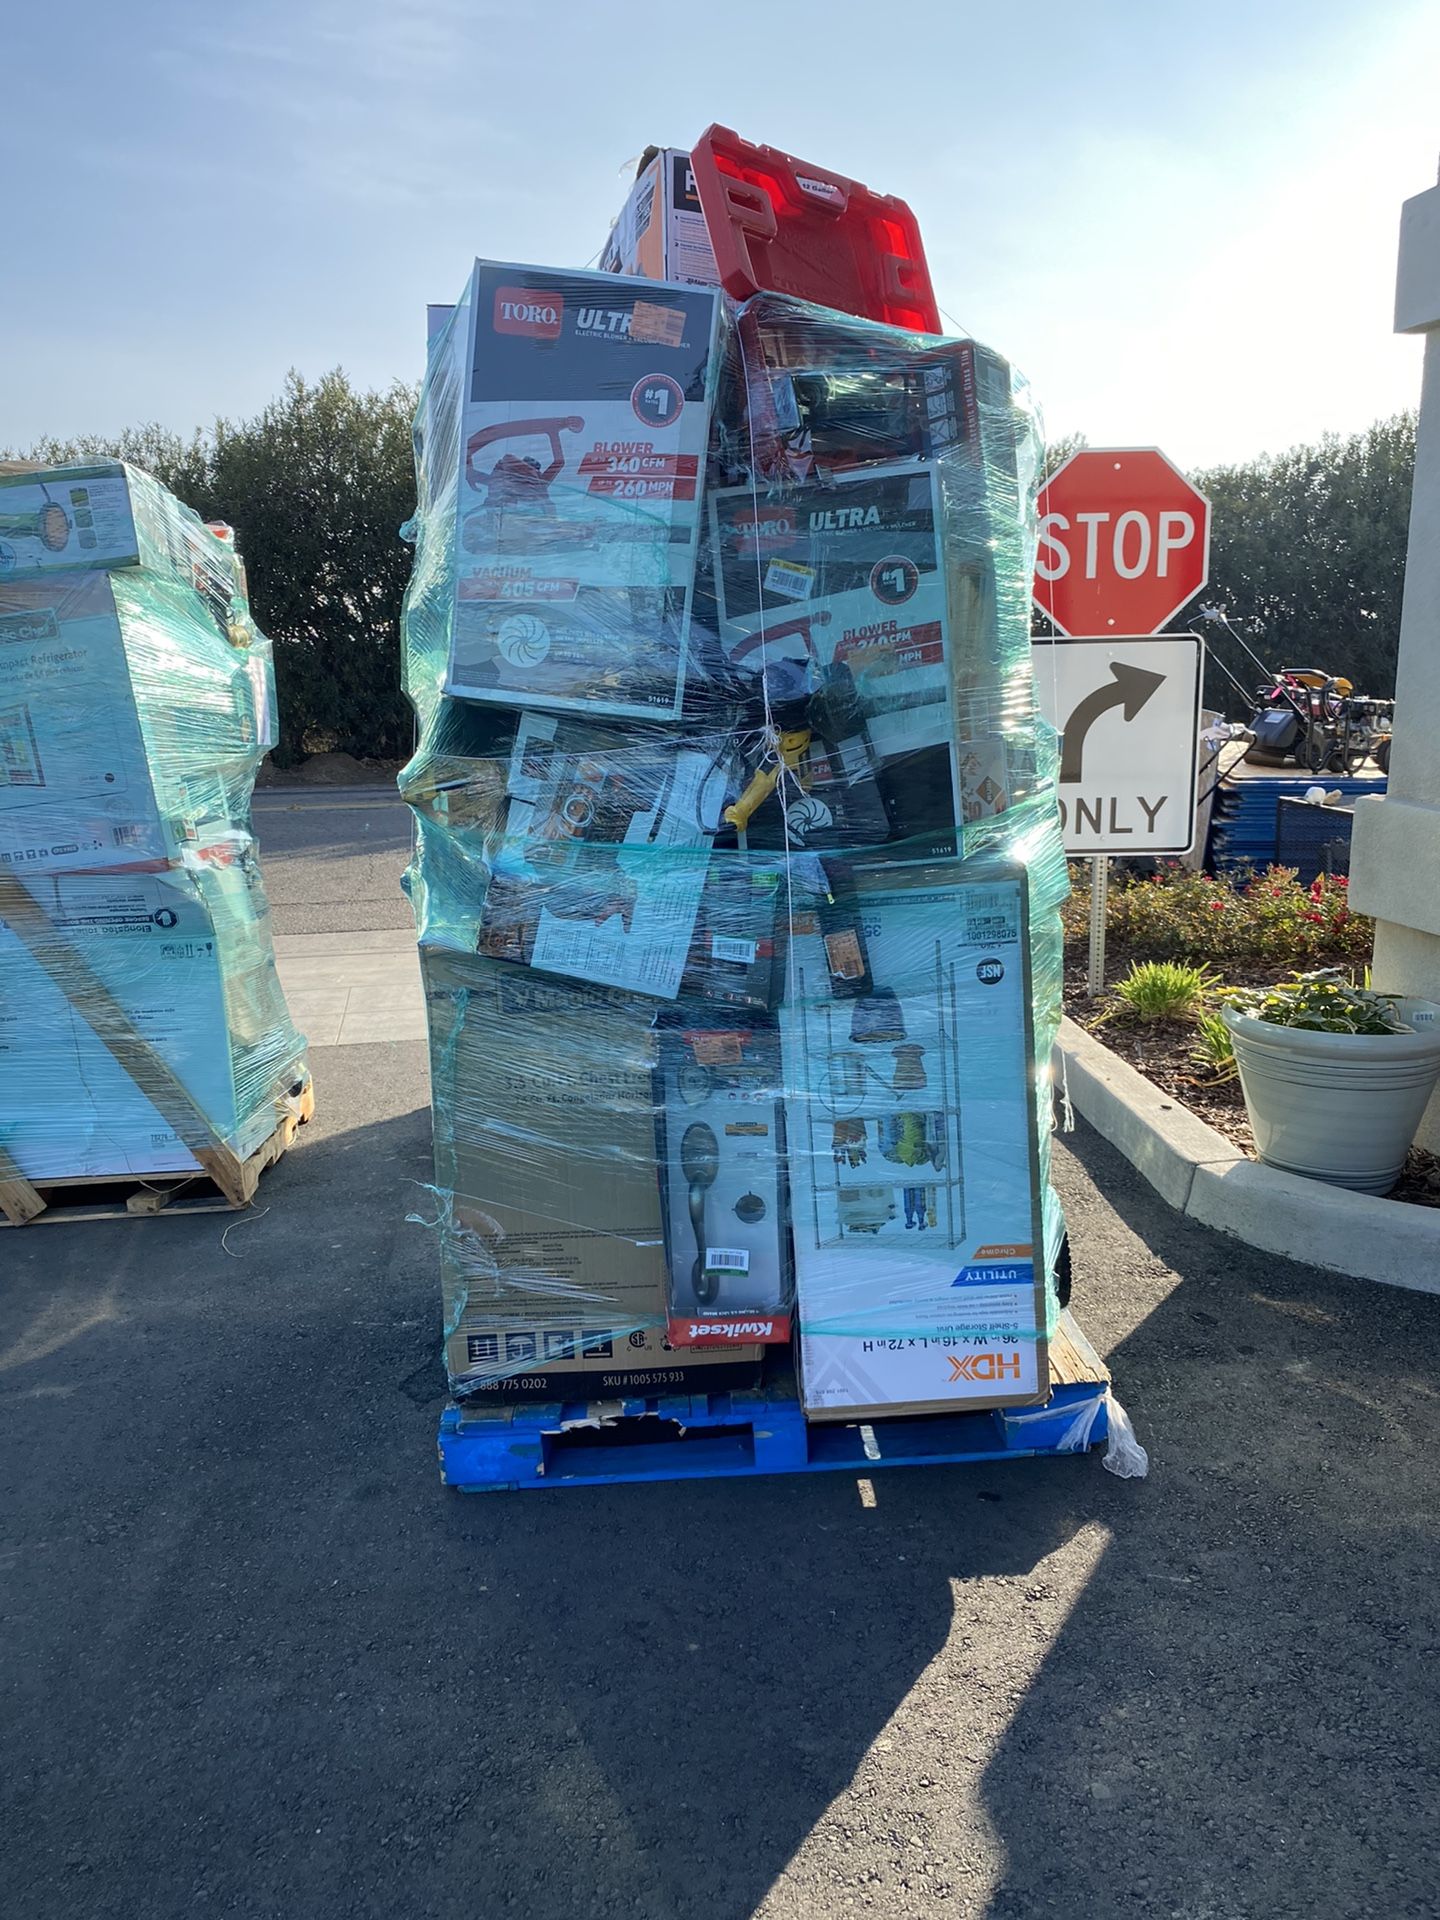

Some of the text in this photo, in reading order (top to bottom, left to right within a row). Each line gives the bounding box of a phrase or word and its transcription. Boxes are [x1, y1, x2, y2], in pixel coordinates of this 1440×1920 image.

[500, 302, 557, 325] TORO
[593, 441, 654, 454] BLOWER
[607, 456, 640, 473] 340
[641, 457, 665, 468] CFM
[612, 480, 647, 496] 260
[648, 481, 674, 492] MPH
[809, 505, 881, 532] ULTRA
[1035, 510, 1195, 581] STOP
[472, 566, 532, 579] VACUUM
[843, 620, 897, 641] BLOWER
[889, 630, 911, 643] CFM
[31, 649, 87, 665] Refrigerator
[900, 651, 922, 662] MPH
[980, 964, 1001, 978] NSF
[980, 1248, 1016, 1256] Chrome
[965, 1270, 1017, 1281] UTILITY
[689, 1321, 773, 1338] Kwikset
[956, 1322, 987, 1331] Storage
[863, 1341, 873, 1352] H
[877, 1340, 886, 1349] in
[888, 1339, 904, 1350] 72
[907, 1338, 916, 1347] x
[919, 1337, 928, 1348] L
[931, 1337, 941, 1345] in
[943, 1336, 958, 1347] 16
[973, 1335, 988, 1345] W
[947, 1353, 1020, 1381] HDX
[480, 1378, 547, 1391] 888 775 0202
[603, 1375, 621, 1386] SKU
[653, 1373, 667, 1384] 575
[669, 1371, 684, 1382] 933
